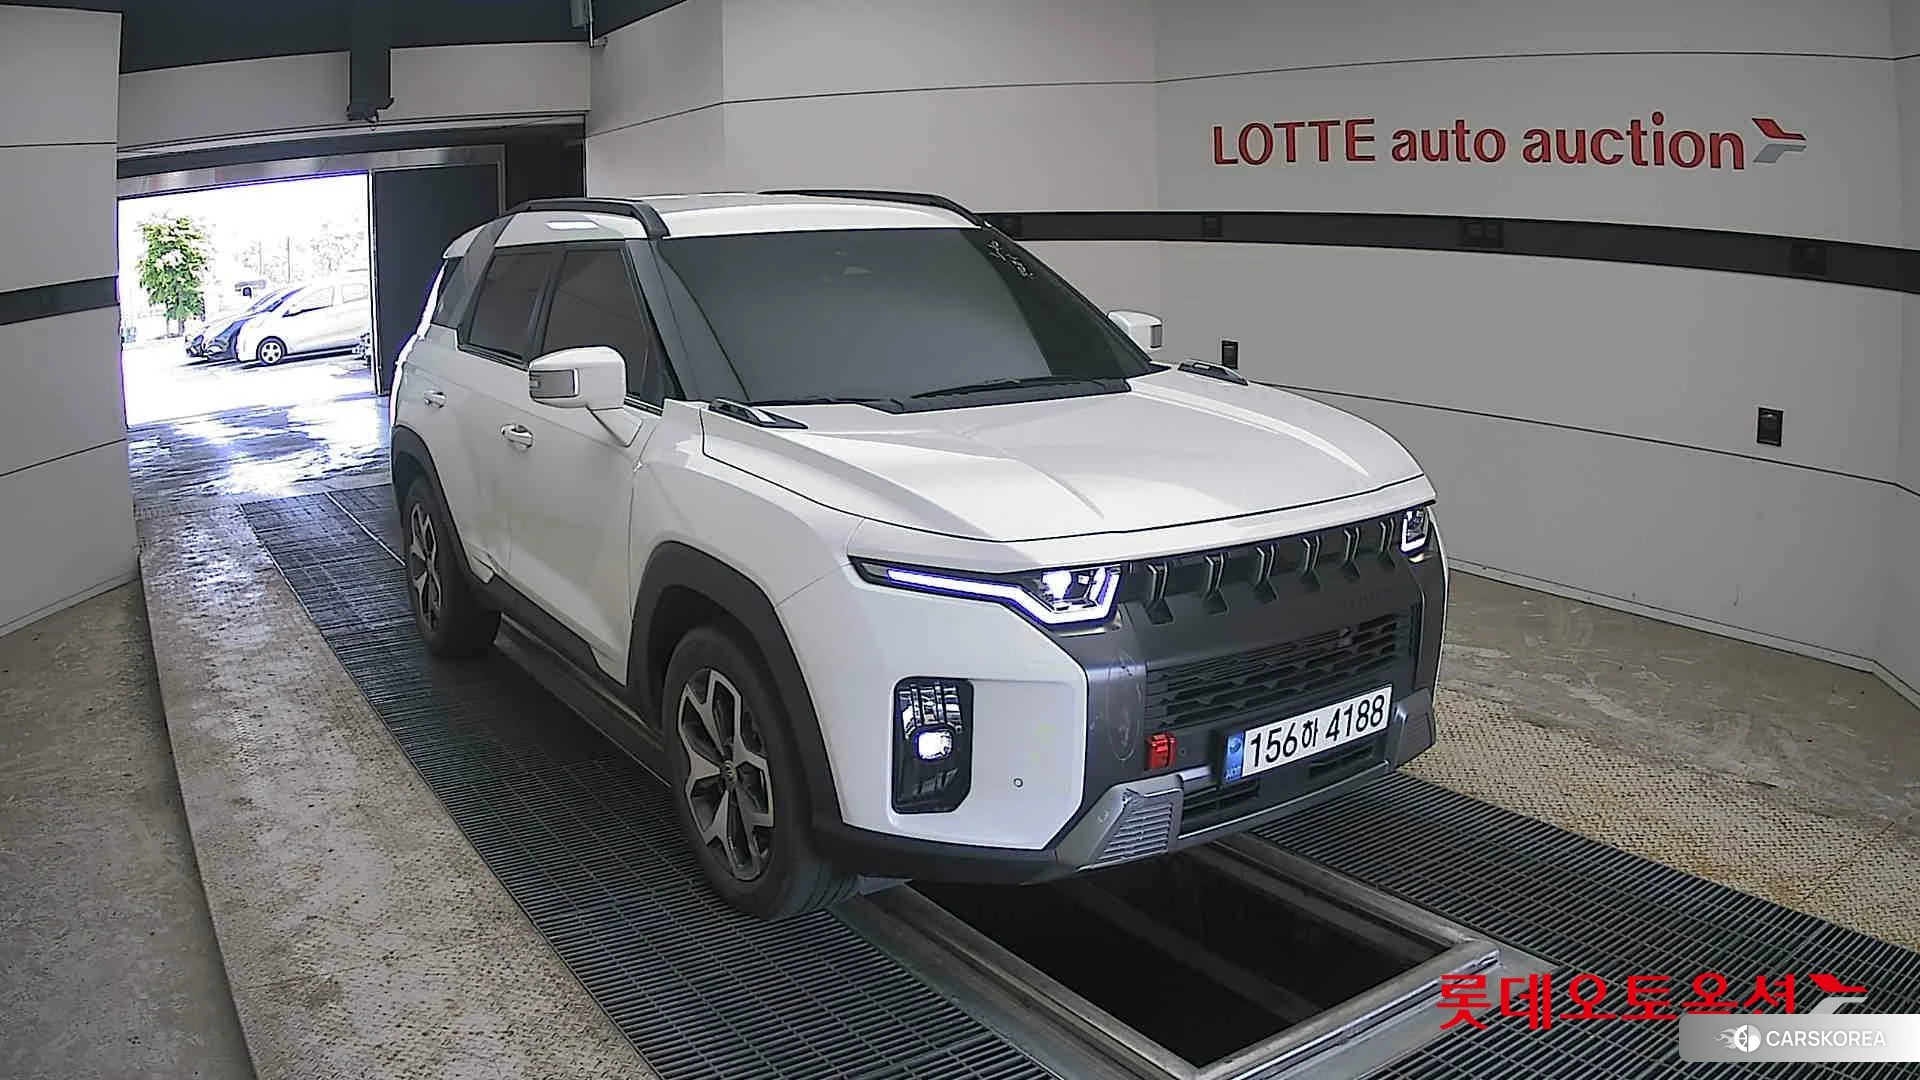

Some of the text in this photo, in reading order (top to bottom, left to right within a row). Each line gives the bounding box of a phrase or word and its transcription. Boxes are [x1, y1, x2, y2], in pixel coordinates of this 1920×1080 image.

[1213, 110, 1745, 170] LOTTE auto auction
[1250, 694, 1385, 768] 156하 4188
